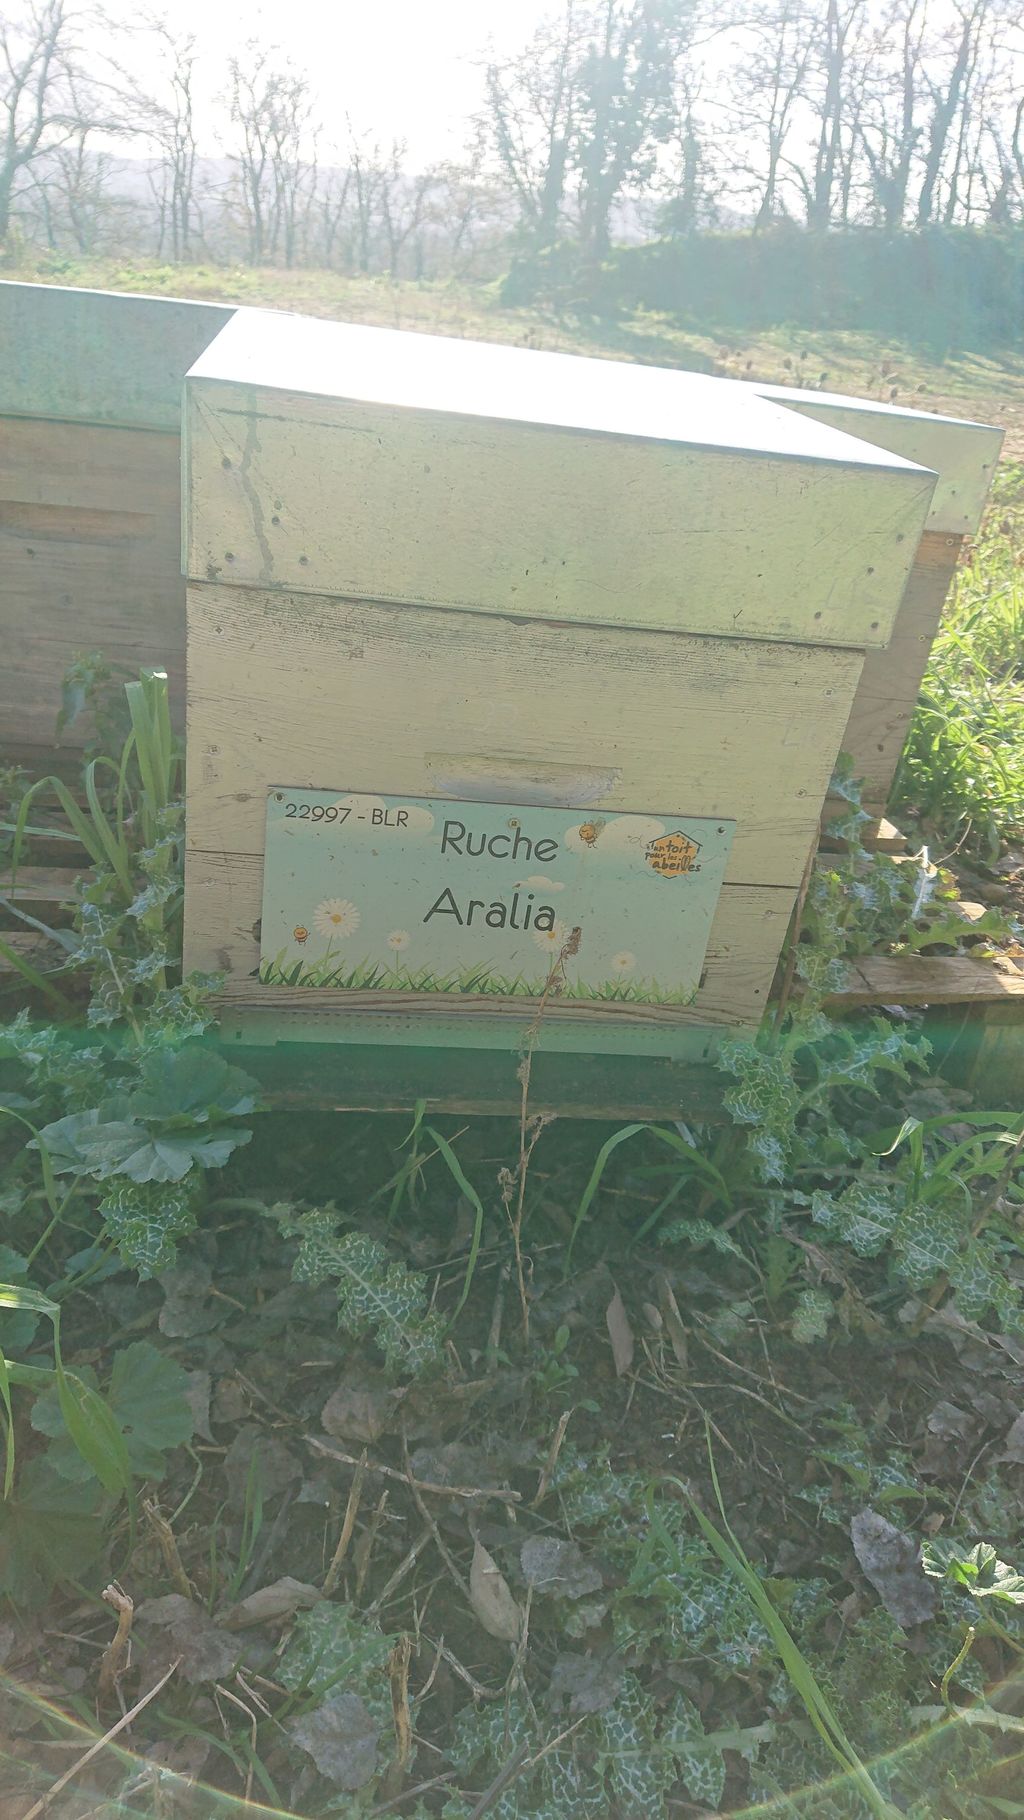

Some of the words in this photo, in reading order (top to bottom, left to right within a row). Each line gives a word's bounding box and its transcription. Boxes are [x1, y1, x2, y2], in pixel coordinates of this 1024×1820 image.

[440, 820, 559, 862] Ruche
[666, 839, 693, 854] toit
[644, 852, 666, 860] pour
[652, 855, 702, 872] abeilles
[422, 887, 556, 931] Aralia
